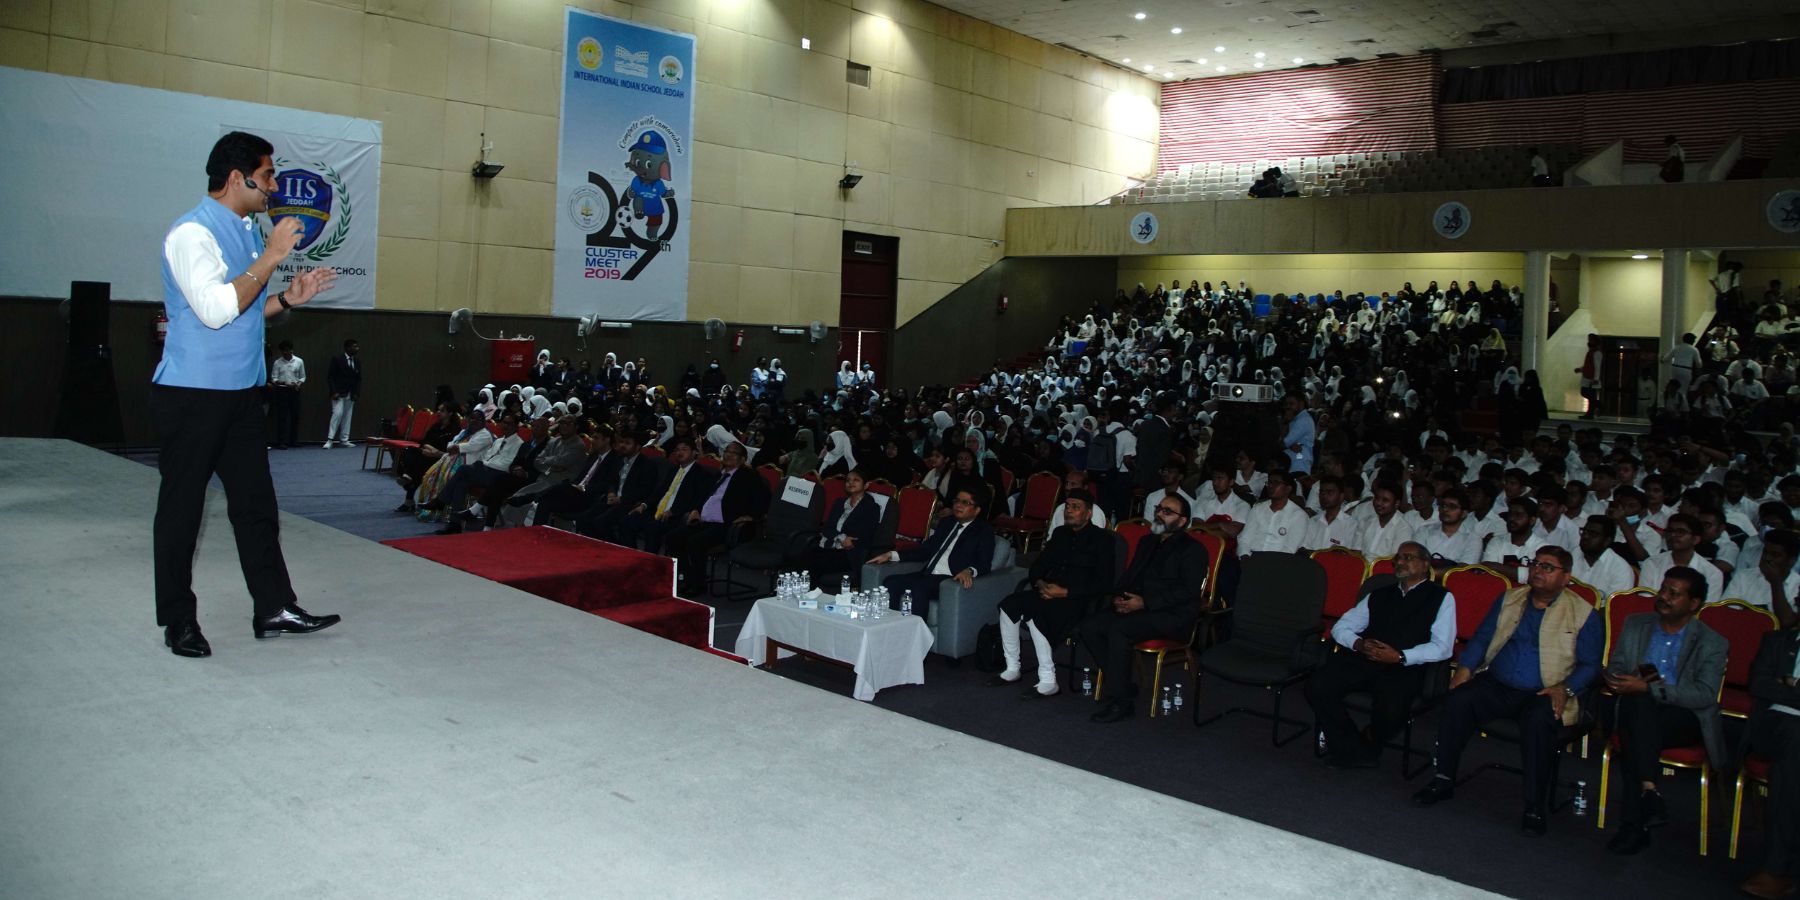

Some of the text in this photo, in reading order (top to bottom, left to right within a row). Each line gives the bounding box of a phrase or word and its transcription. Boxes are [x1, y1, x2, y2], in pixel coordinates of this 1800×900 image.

[574, 70, 684, 99] INTERNATIONAL INDIAN SCHOOL JEDDAH
[640, 116, 654, 126] with
[284, 177, 317, 199] IIS
[286, 198, 314, 206] JEDDAH
[585, 247, 638, 260] CLUSTER
[585, 257, 620, 268] MEET
[331, 266, 367, 276] CHOOL
[584, 268, 621, 280] 2019
[788, 485, 809, 497] RESERVED
